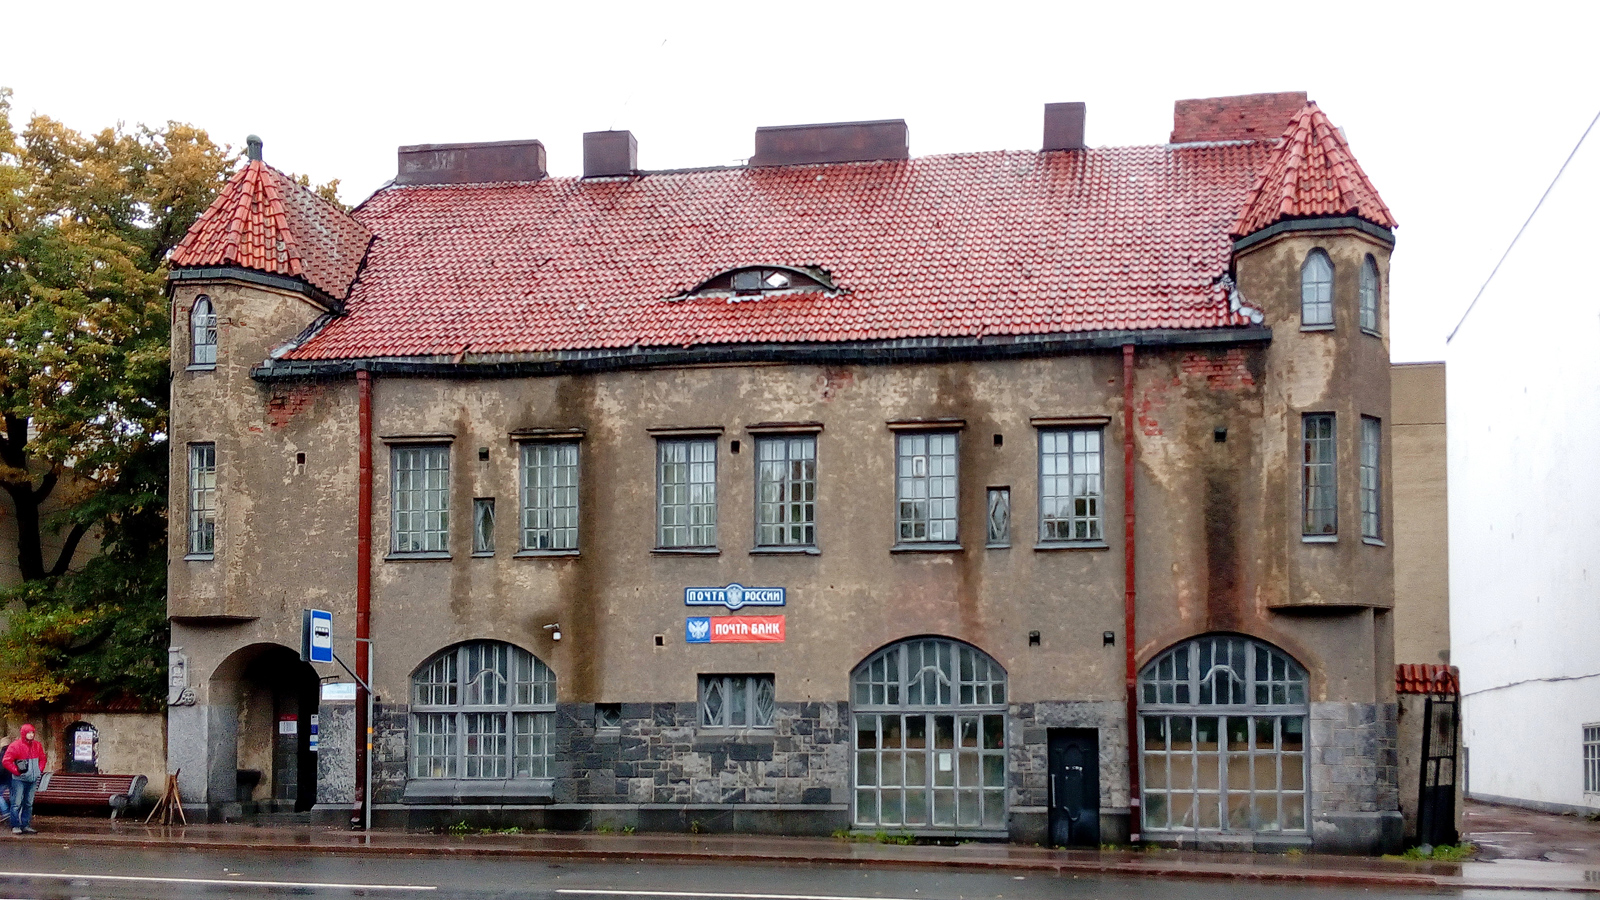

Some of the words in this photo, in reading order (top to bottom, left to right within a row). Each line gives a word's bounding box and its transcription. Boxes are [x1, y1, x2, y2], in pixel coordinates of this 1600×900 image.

[690, 591, 725, 601] ПОЧТА
[745, 591, 780, 601] РОССИИ
[715, 623, 748, 635] ПОЧТА
[751, 623, 780, 635] БАНК
